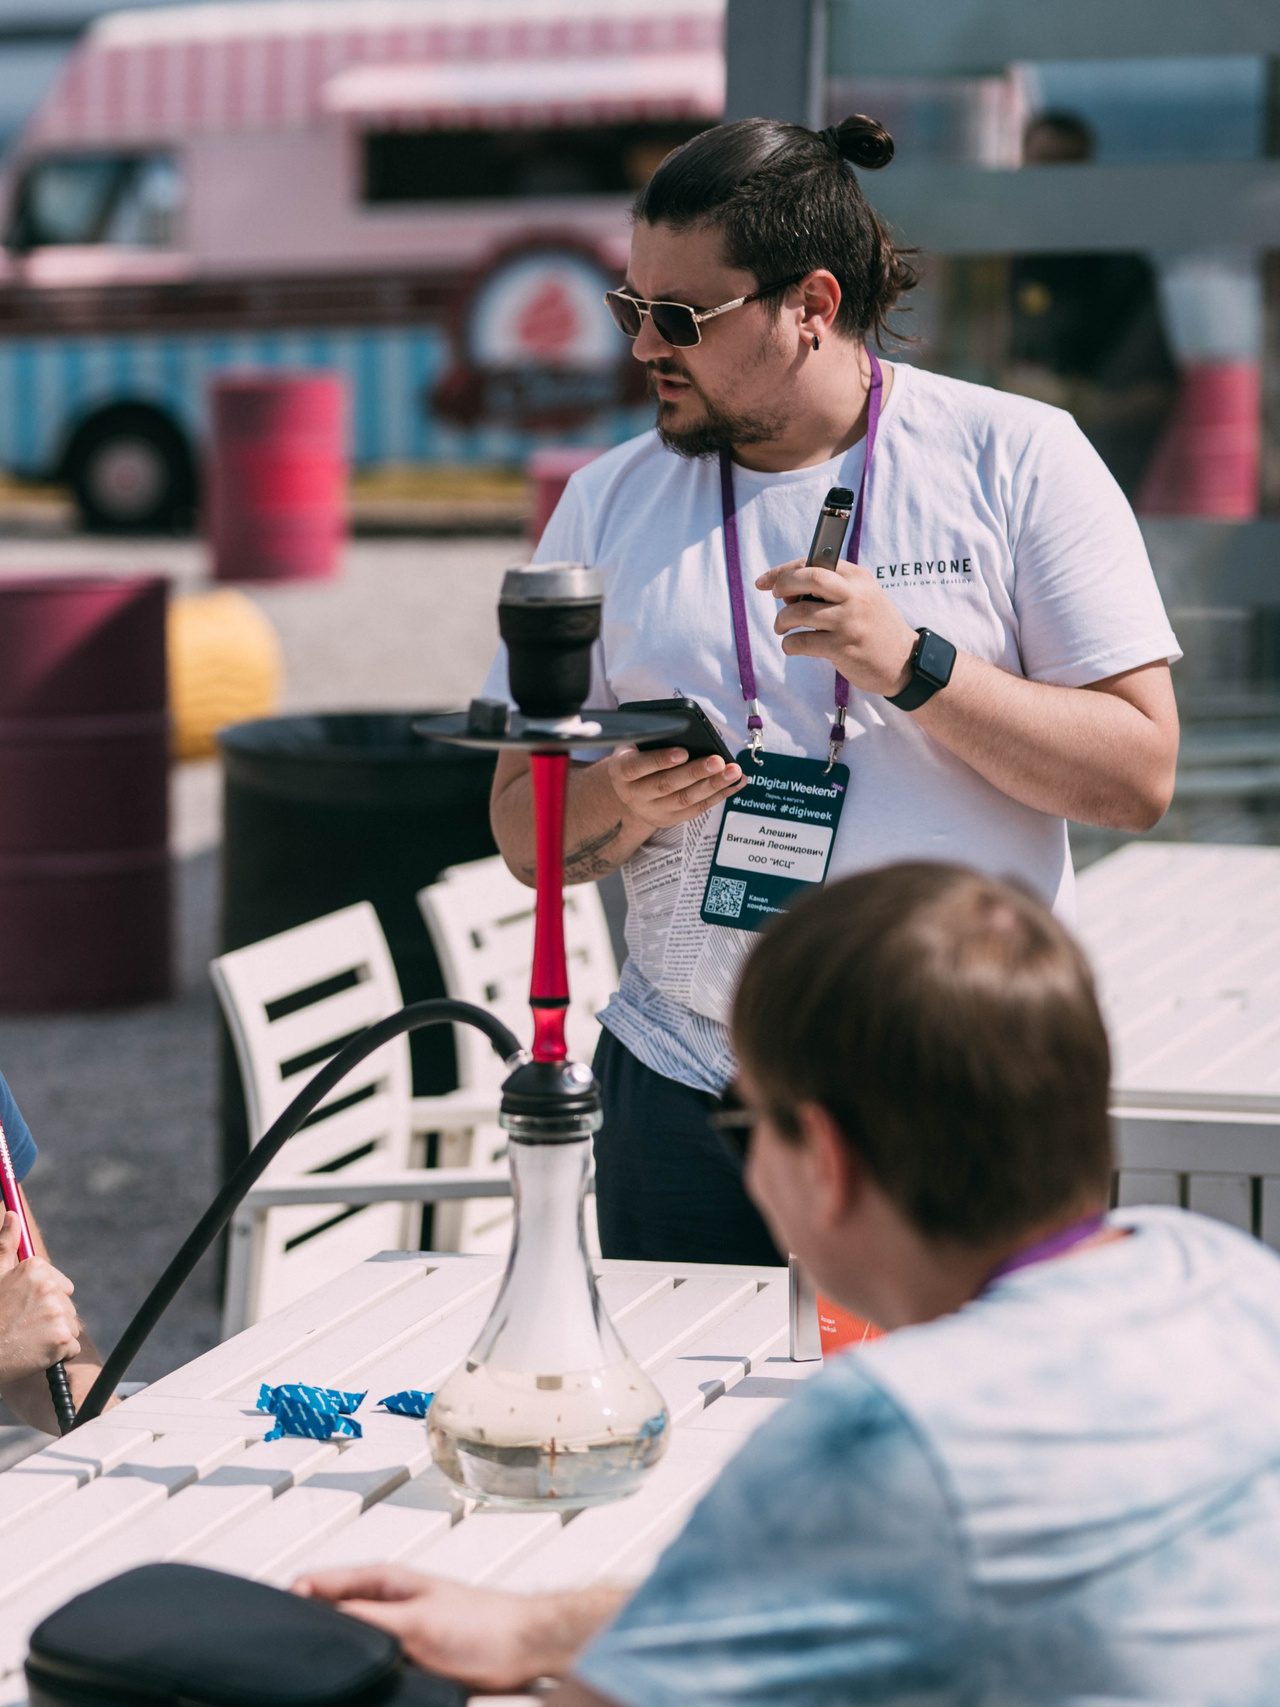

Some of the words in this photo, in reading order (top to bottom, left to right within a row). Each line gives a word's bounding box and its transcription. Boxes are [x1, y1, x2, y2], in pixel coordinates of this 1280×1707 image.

[876, 558, 971, 579] EVERYONE
[756, 776, 790, 790] Digital
[790, 781, 838, 799] Weekend
[733, 797, 777, 812] #udweek
[780, 804, 833, 822] #digiweek
[758, 826, 798, 840] Алешин
[726, 833, 765, 847] Виталий
[767, 840, 824, 858] Леонидович
[748, 894, 769, 903] Канал
